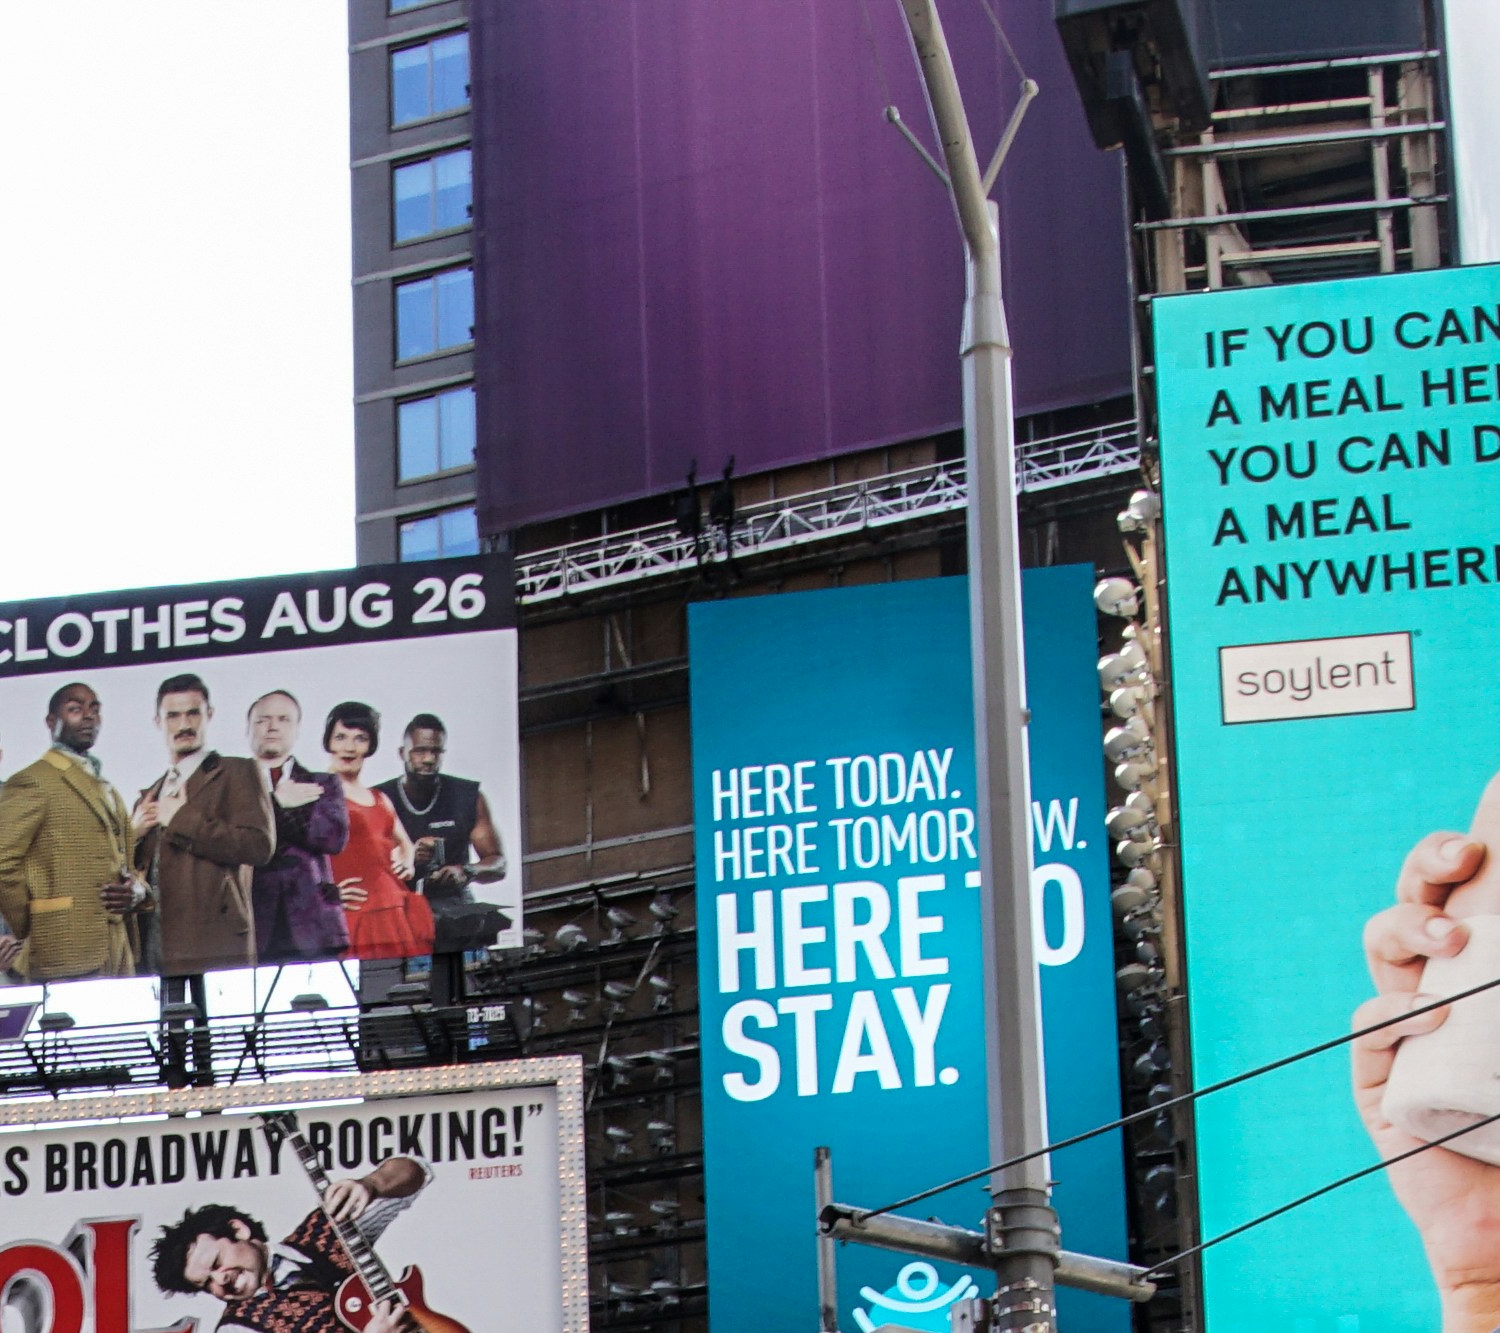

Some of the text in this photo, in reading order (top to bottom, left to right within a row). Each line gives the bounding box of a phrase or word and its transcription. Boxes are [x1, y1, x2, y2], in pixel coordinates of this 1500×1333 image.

[1204, 327, 1249, 369] IF
[1264, 315, 1373, 362] YOU
[1205, 388, 1243, 428] A
[1259, 375, 1404, 424] MEAL
[1208, 439, 1318, 486] YOU
[1338, 427, 1450, 474] CAN
[1212, 493, 1411, 547] A MEAL
[262, 582, 395, 636] AUG
[412, 571, 484, 623] 26
[1236, 650, 1397, 701] soylent
[712, 747, 962, 821] HERE TODAY.
[713, 797, 1088, 882] HERE TOMORW.
[716, 874, 949, 994] HERE
[721, 983, 960, 1103] STAY.
[44, 1121, 288, 1195] BROADWAY
[468, 1164, 524, 1181] REUTERS
